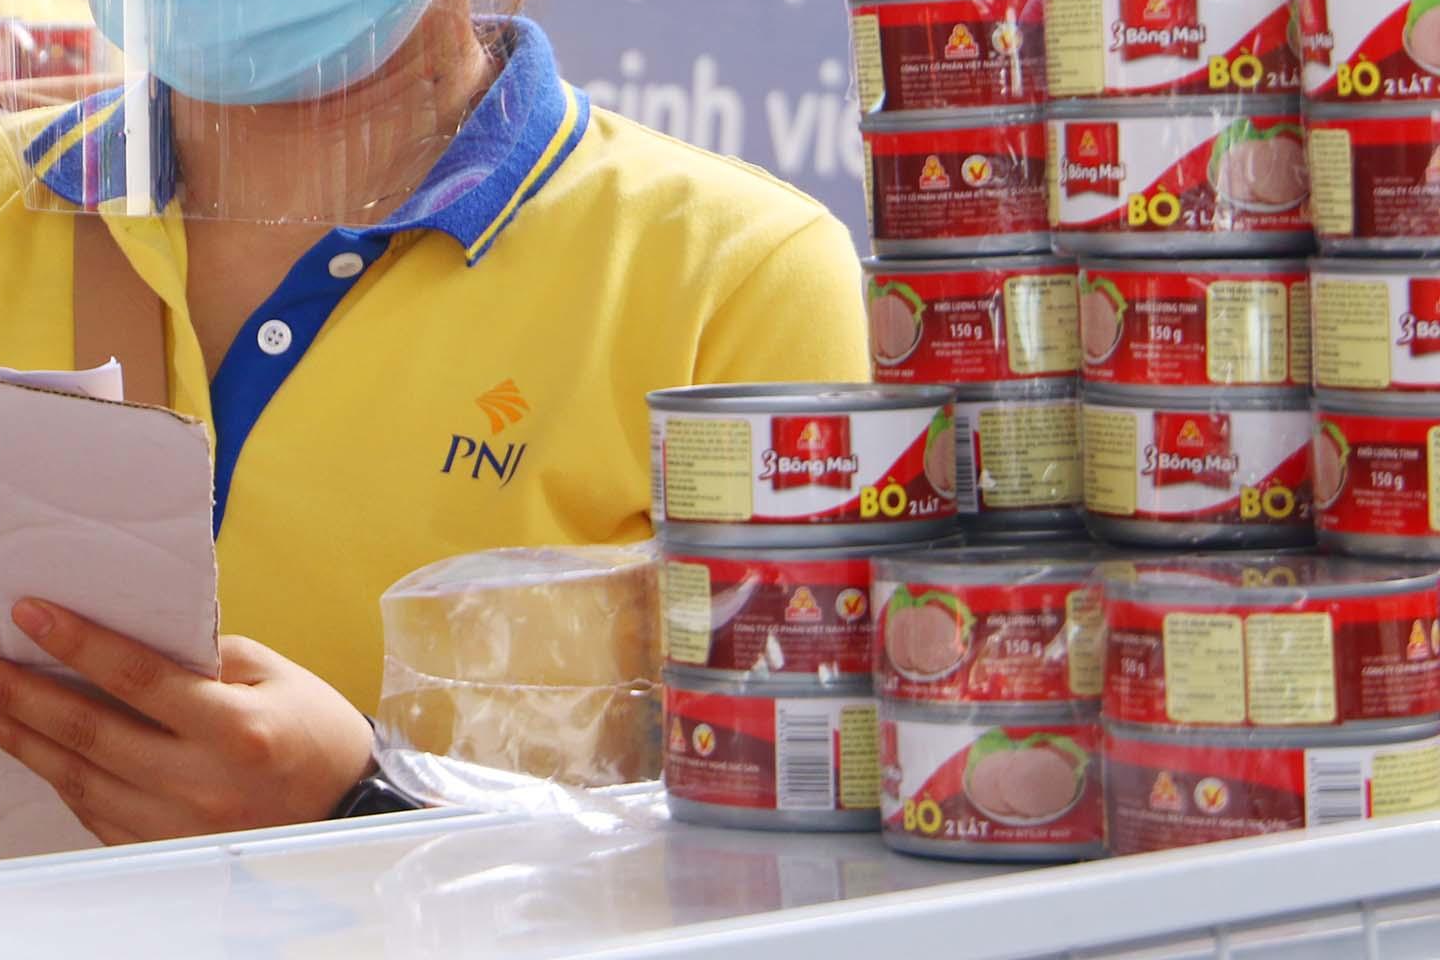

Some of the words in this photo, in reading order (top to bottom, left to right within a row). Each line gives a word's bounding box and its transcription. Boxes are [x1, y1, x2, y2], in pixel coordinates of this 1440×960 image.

[1126, 24, 1170, 49] Bông
[1173, 22, 1207, 44] Mai
[1209, 46, 1264, 89] BÒ
[1266, 74, 1278, 88] 2
[1280, 70, 1301, 87] LÁ
[1337, 52, 1381, 96] BÒ
[1384, 78, 1395, 96] 2
[1397, 72, 1432, 95] LÁT
[764, 58, 864, 178] vi
[1098, 162, 1126, 181] Mai
[1126, 183, 1182, 227] BÒ
[1183, 209, 1196, 225] 2
[950, 323, 972, 339] 150
[974, 326, 983, 340] g
[1150, 324, 1171, 341] 150
[1172, 328, 1182, 344] g
[1395, 312, 1417, 346] 3
[440, 434, 527, 489] PNJ
[758, 448, 776, 481] 3
[777, 457, 825, 477] Bông
[825, 452, 859, 474] Mai
[1158, 452, 1203, 475] Bông
[1204, 453, 1239, 473] Mai
[860, 475, 907, 518] BÒ
[909, 500, 919, 516] 2
[919, 495, 940, 515] LÁT
[1239, 477, 1295, 520] BÒ
[1370, 471, 1393, 488] 150
[1393, 474, 1404, 492] g
[1006, 639, 1028, 654] 150
[1031, 641, 1043, 657] g
[903, 792, 943, 834] BÒ
[945, 818, 954, 836] 2
[956, 816, 990, 837] LÁT
